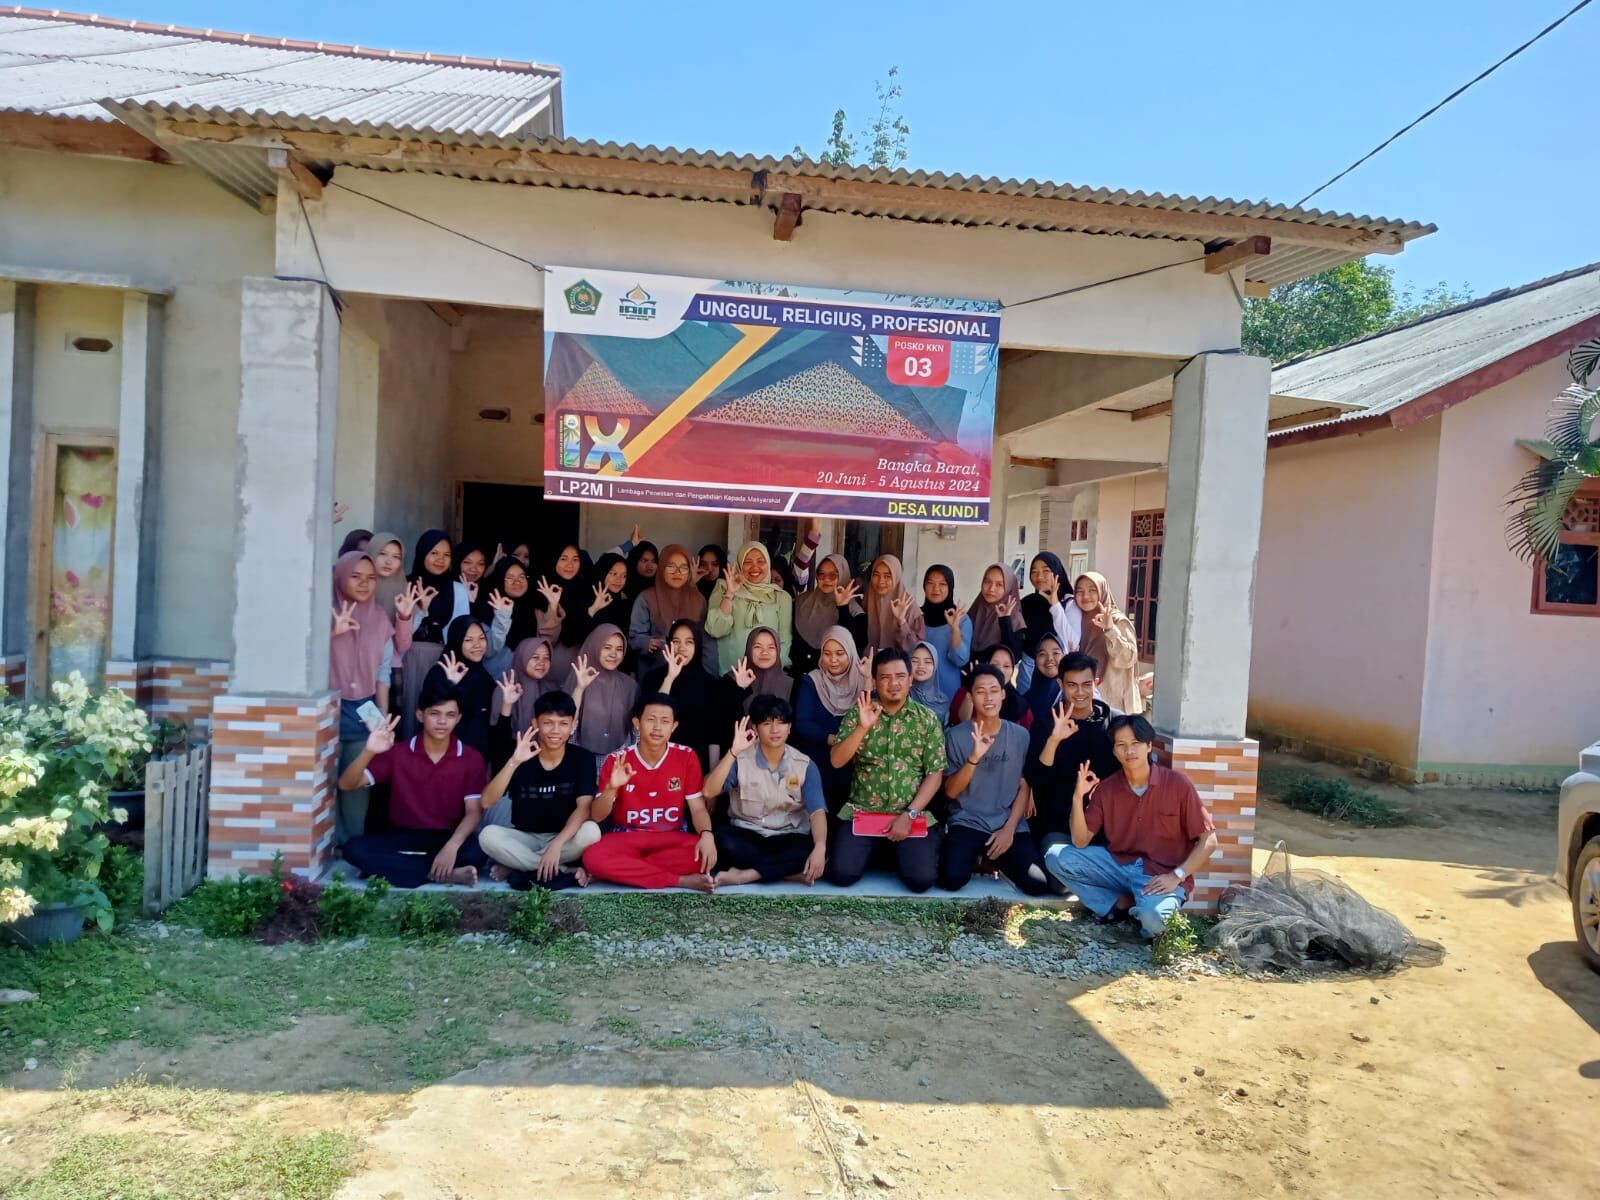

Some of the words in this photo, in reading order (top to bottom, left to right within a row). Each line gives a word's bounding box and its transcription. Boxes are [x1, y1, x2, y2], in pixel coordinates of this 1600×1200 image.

[699, 300, 777, 324] UNGGUL,
[782, 307, 866, 331] RELIGIUS,
[871, 314, 991, 338] PROFESIONAL
[894, 341, 925, 352] POSKO
[926, 343, 945, 353] KKN
[904, 356, 932, 378] 03
[877, 458, 932, 475] Bangka
[935, 462, 980, 477] Barat,
[560, 480, 603, 497] LP2M
[817, 471, 833, 483] 20
[834, 472, 867, 486] Juni
[878, 475, 886, 487] 5
[889, 476, 945, 491] Agustus
[948, 479, 980, 492] 2024
[888, 502, 928, 517] DESA
[932, 504, 979, 518] KUNDI
[627, 806, 679, 825] PSFC
